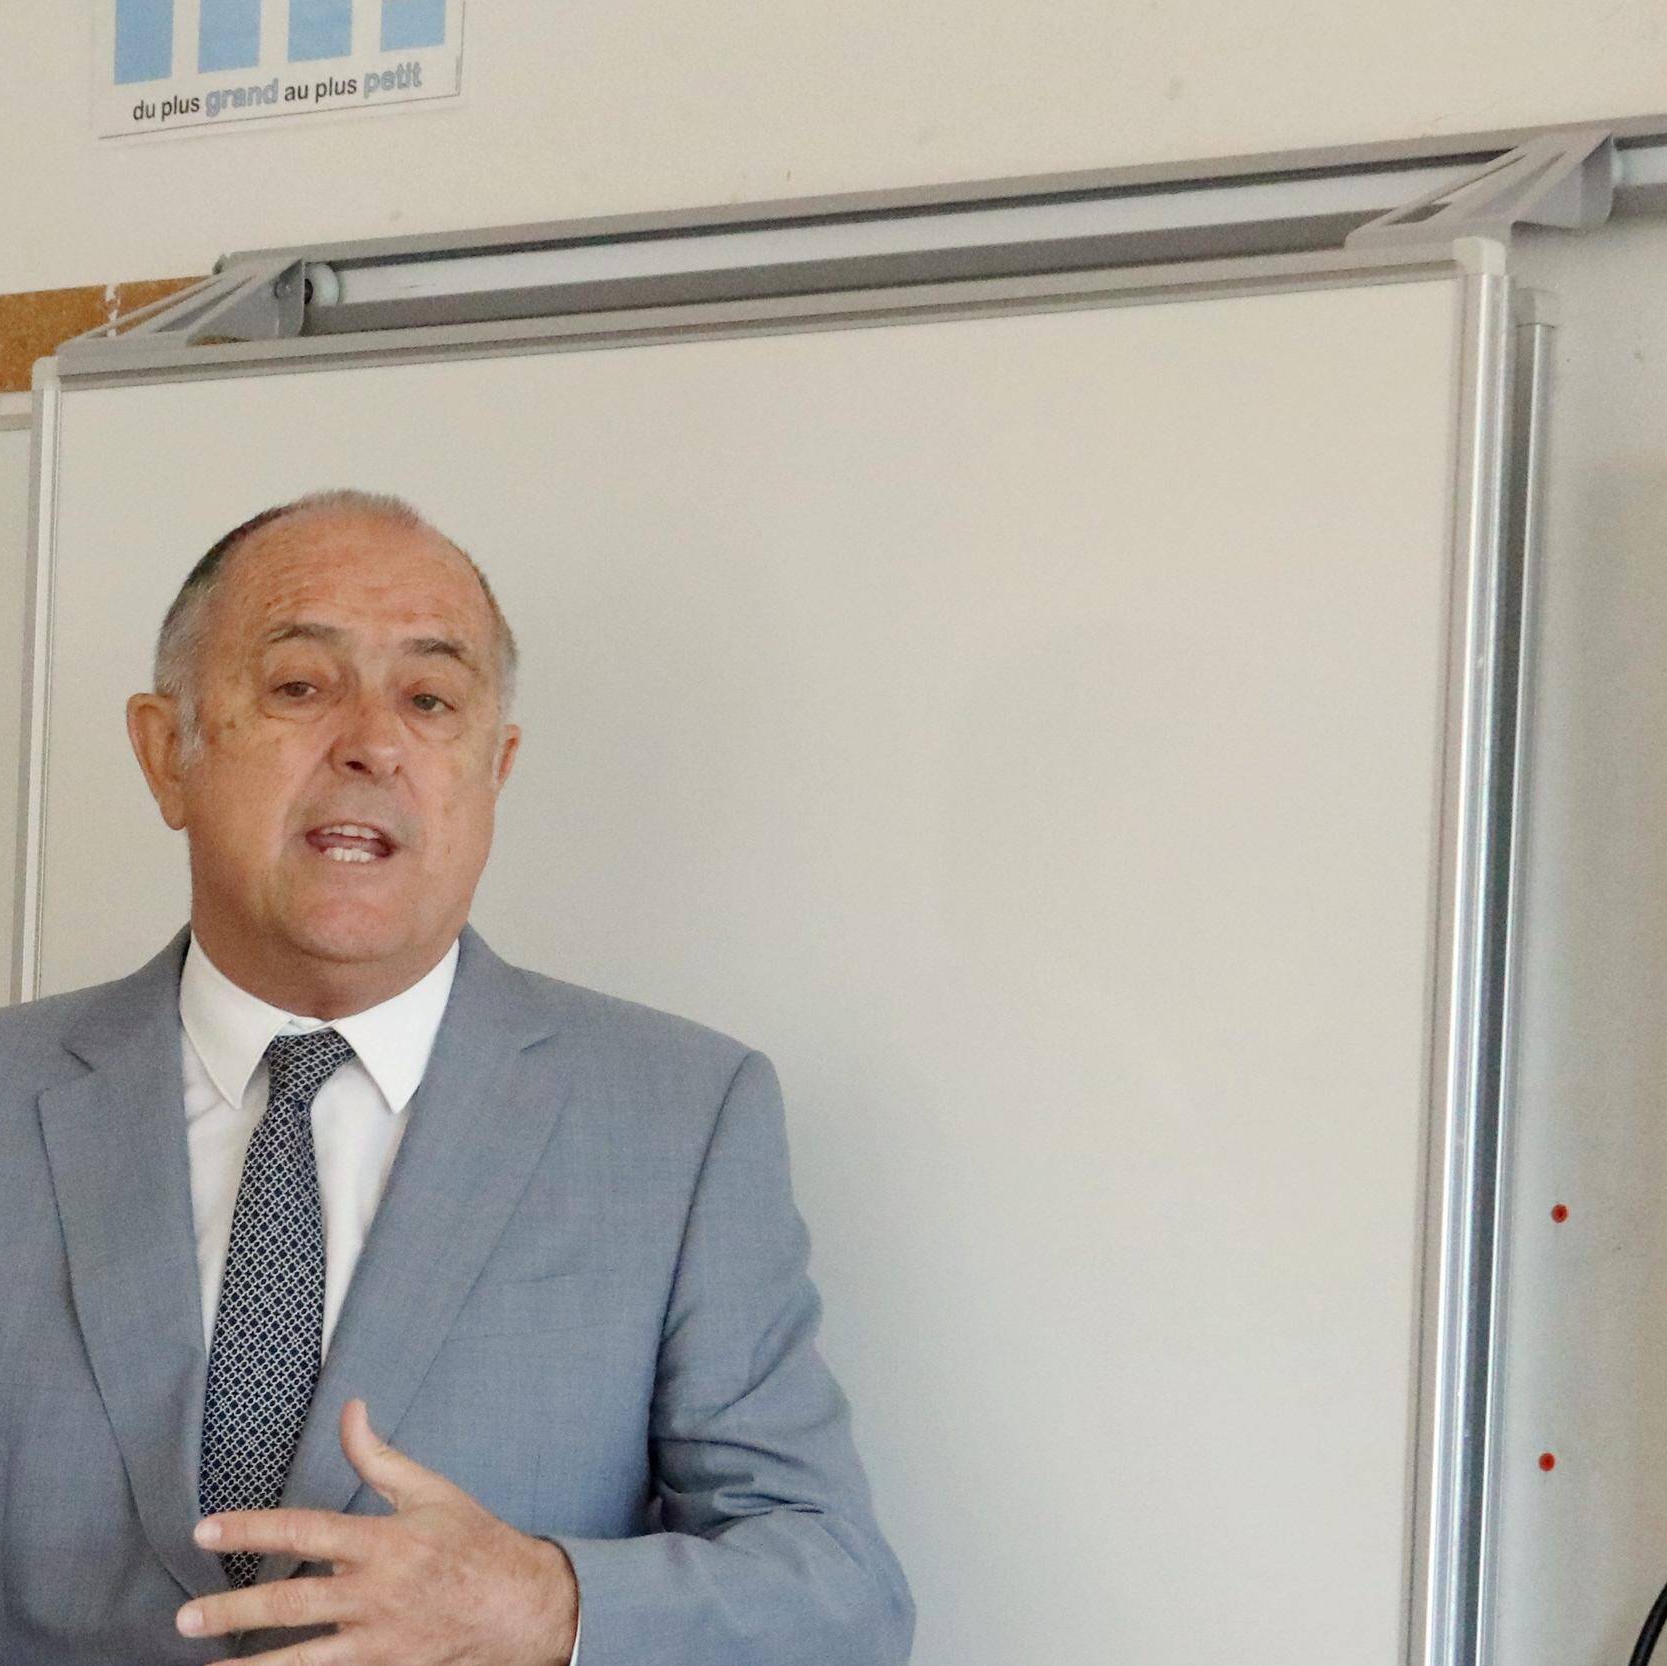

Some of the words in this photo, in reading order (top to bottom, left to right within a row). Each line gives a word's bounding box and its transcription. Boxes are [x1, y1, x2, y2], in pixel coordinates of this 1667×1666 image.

[133, 100, 156, 120] du
[161, 95, 200, 121] plus
[205, 78, 279, 117] grand
[284, 82, 309, 102] au
[315, 76, 358, 103] plus
[363, 61, 423, 98] petit
